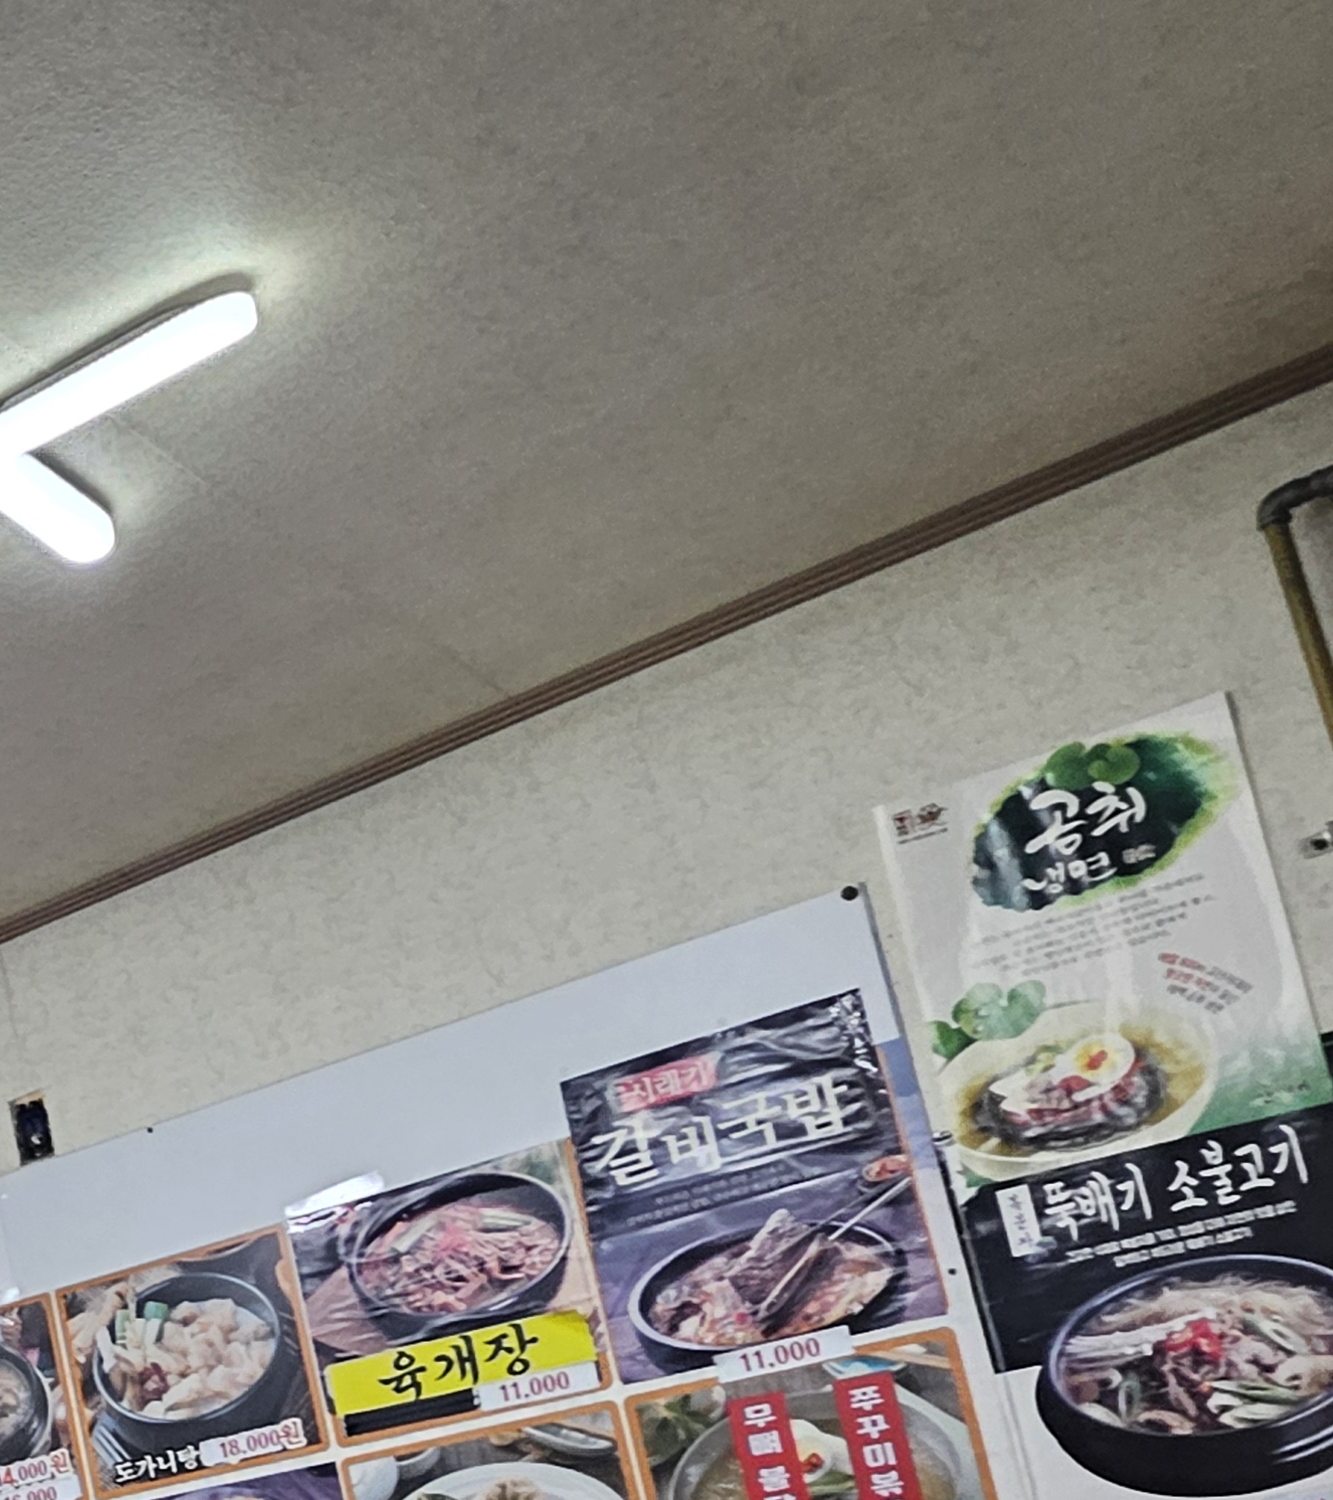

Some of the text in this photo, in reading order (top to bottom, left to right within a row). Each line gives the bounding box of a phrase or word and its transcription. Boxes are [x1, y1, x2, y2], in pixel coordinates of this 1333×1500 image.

[1024, 781, 1147, 855] 곰취
[590, 1075, 850, 1187] 갈비국밥
[1042, 1163, 1153, 1242] 뚝배기
[1167, 1124, 1308, 1212] 소불고기
[379, 1323, 538, 1400] 육개장
[114, 1445, 200, 1483] 도가니탕
